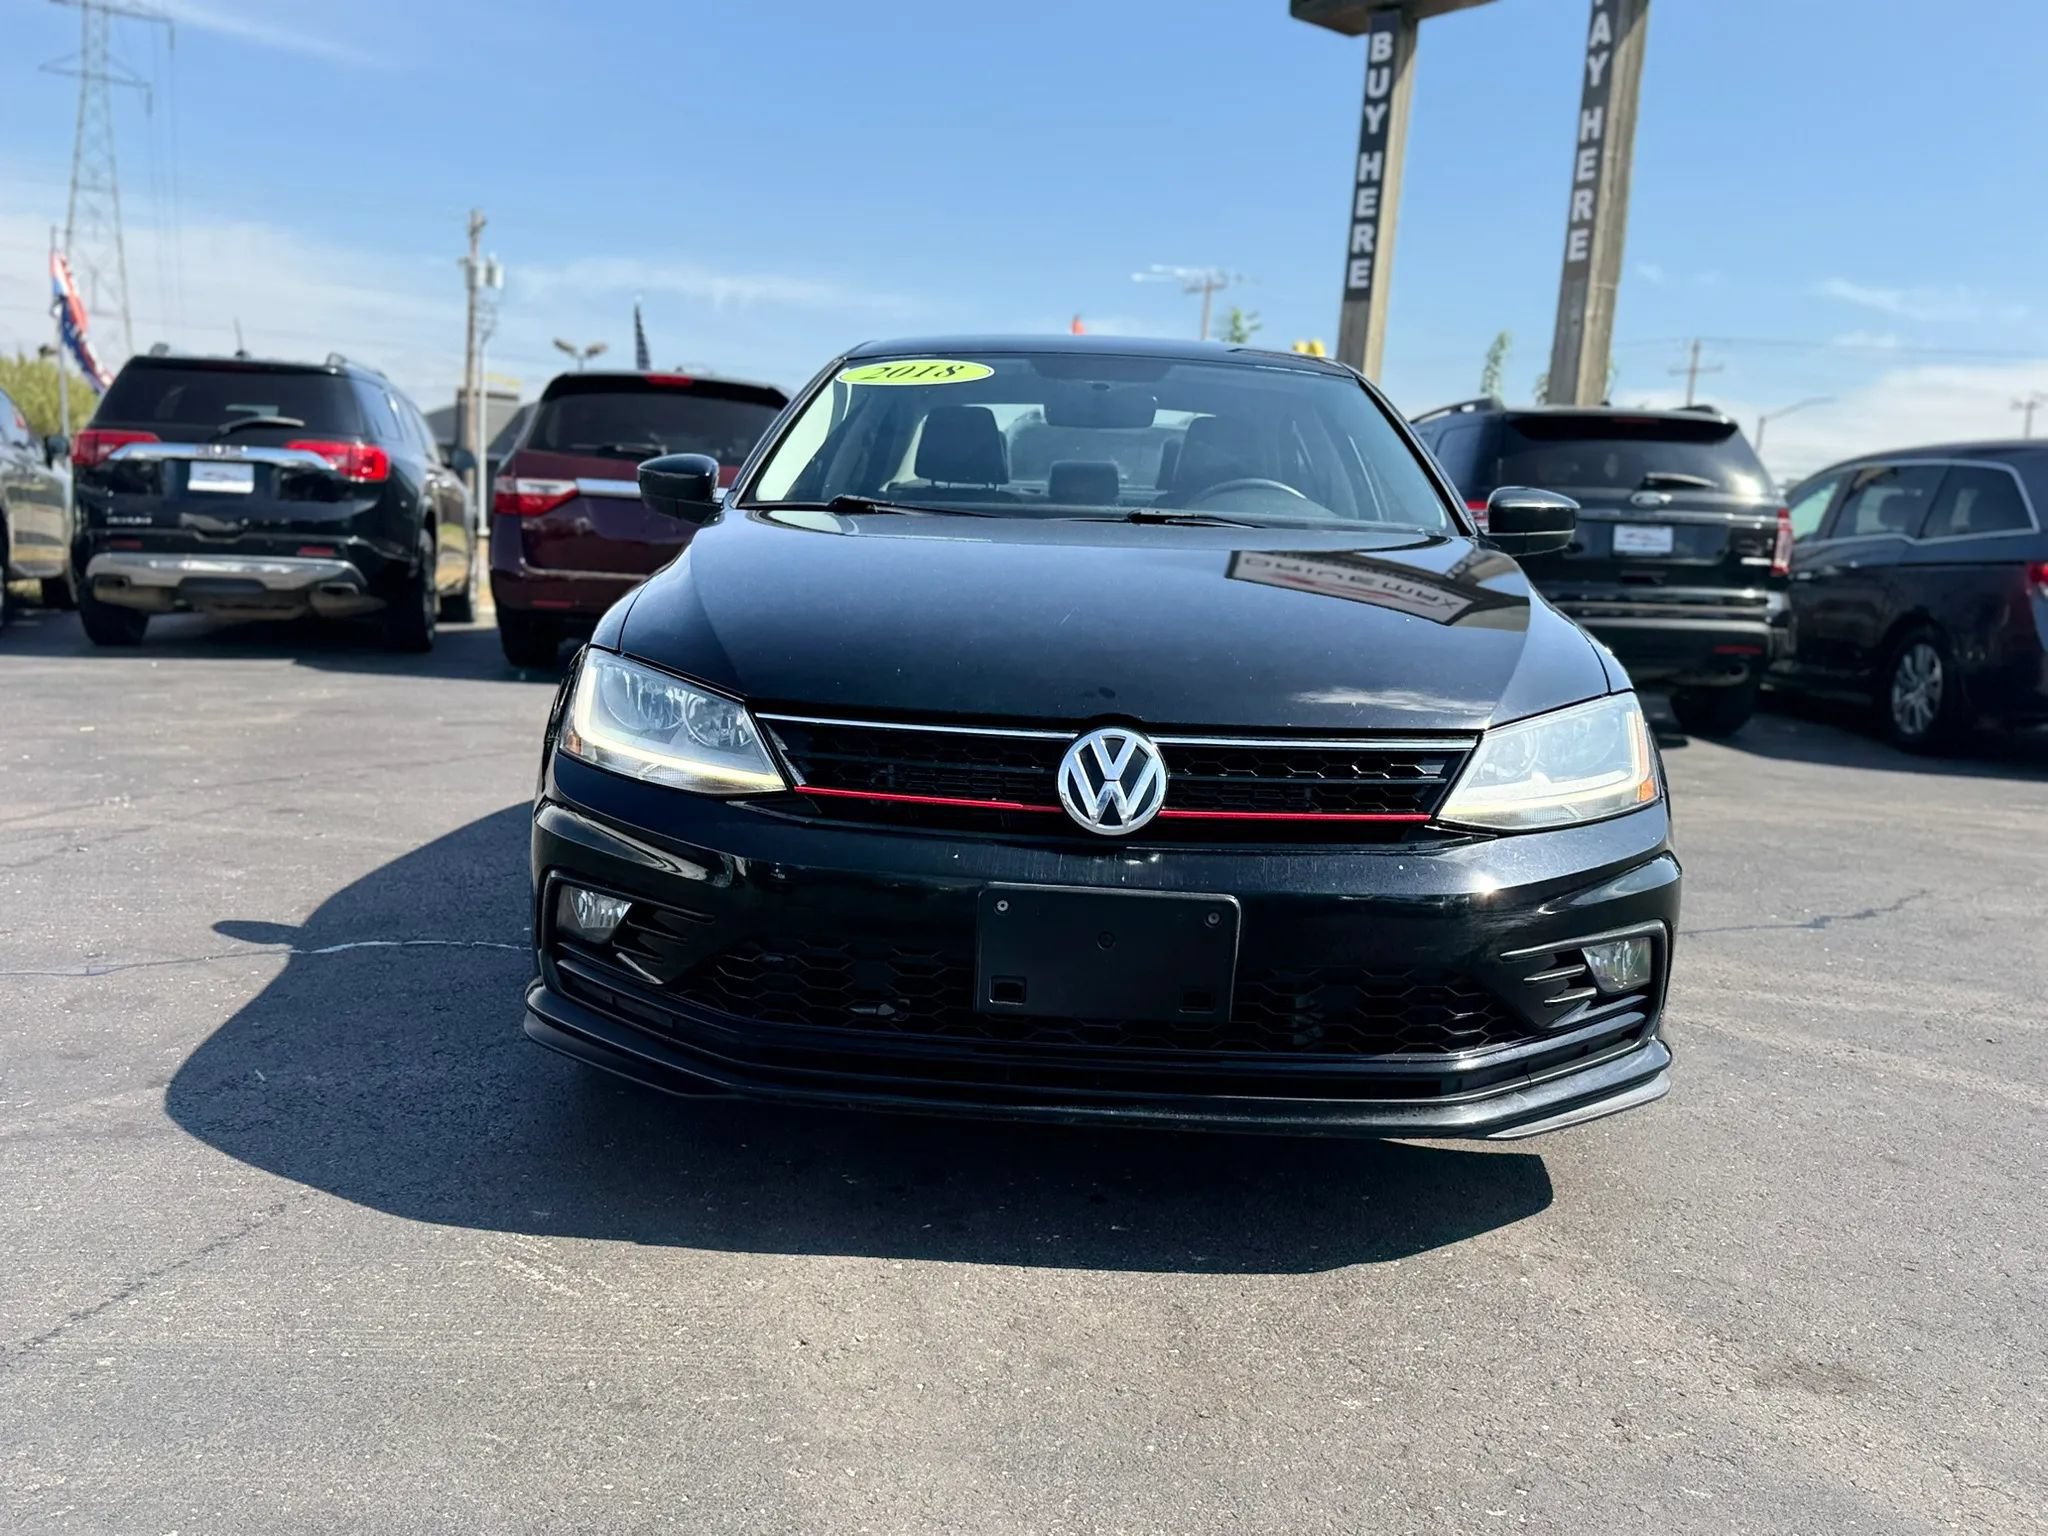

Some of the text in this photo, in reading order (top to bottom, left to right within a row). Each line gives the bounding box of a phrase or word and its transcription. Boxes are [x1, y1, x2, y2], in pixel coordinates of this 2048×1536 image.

[1347, 31, 1392, 289] BUY HERE
[1567, 0, 1612, 262] AY HERE
[860, 364, 965, 380] 2018
[1060, 729, 1167, 834] VW
